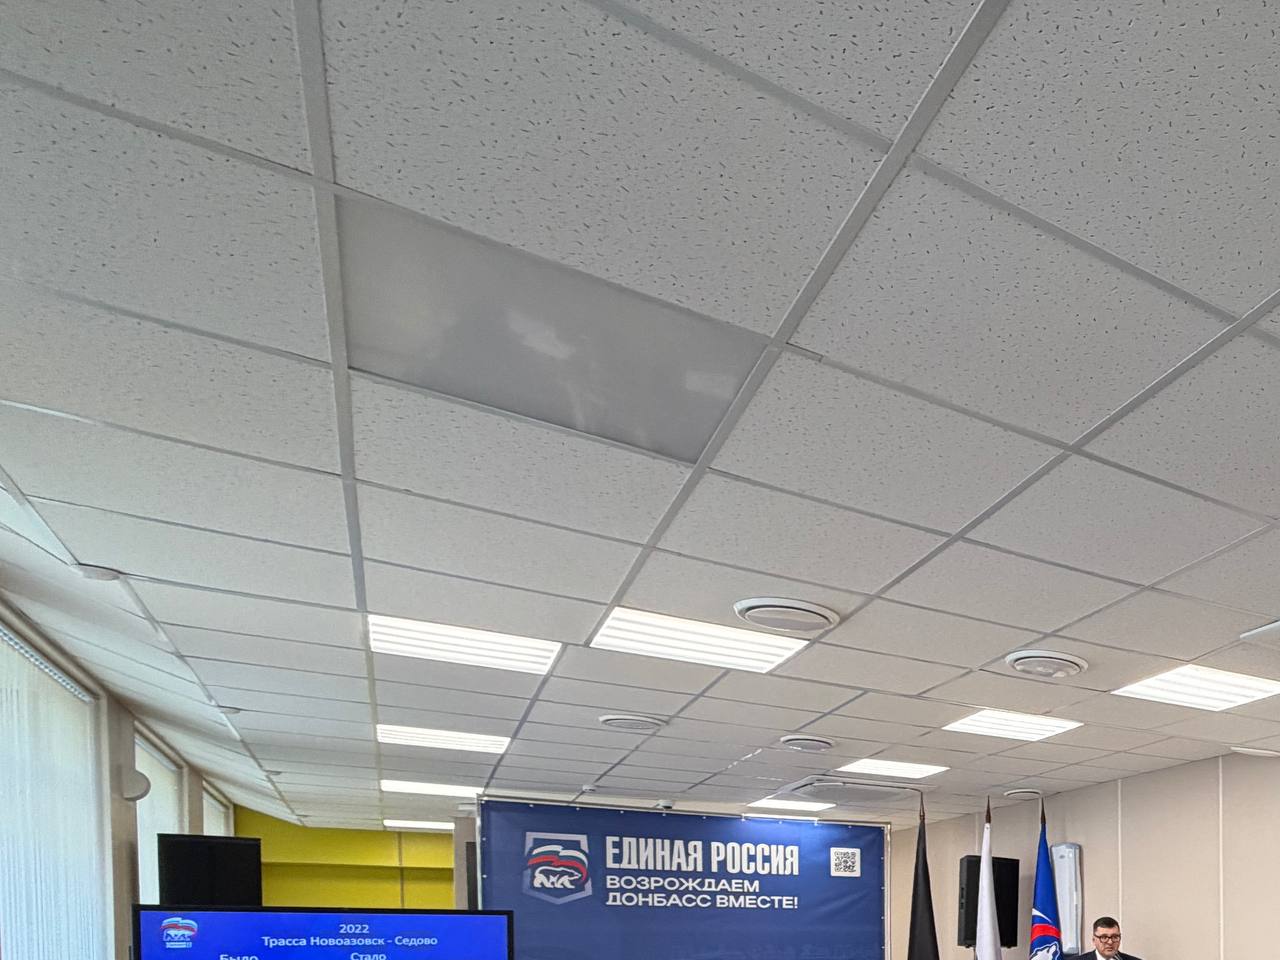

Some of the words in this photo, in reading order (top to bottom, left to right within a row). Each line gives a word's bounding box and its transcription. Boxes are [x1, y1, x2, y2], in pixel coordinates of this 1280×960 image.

[605, 836, 703, 872] ЕДИНАЯ
[711, 841, 799, 875] РОССИЯ
[606, 875, 760, 893] ВОЗРОЖДАЕМ
[606, 892, 711, 907] ДОНБАСС
[716, 895, 798, 909] ВМЕСТЕ!
[339, 924, 370, 934] 2022
[262, 936, 307, 948] Трасса
[310, 936, 385, 946] Новоазовск
[395, 935, 438, 946] Седово
